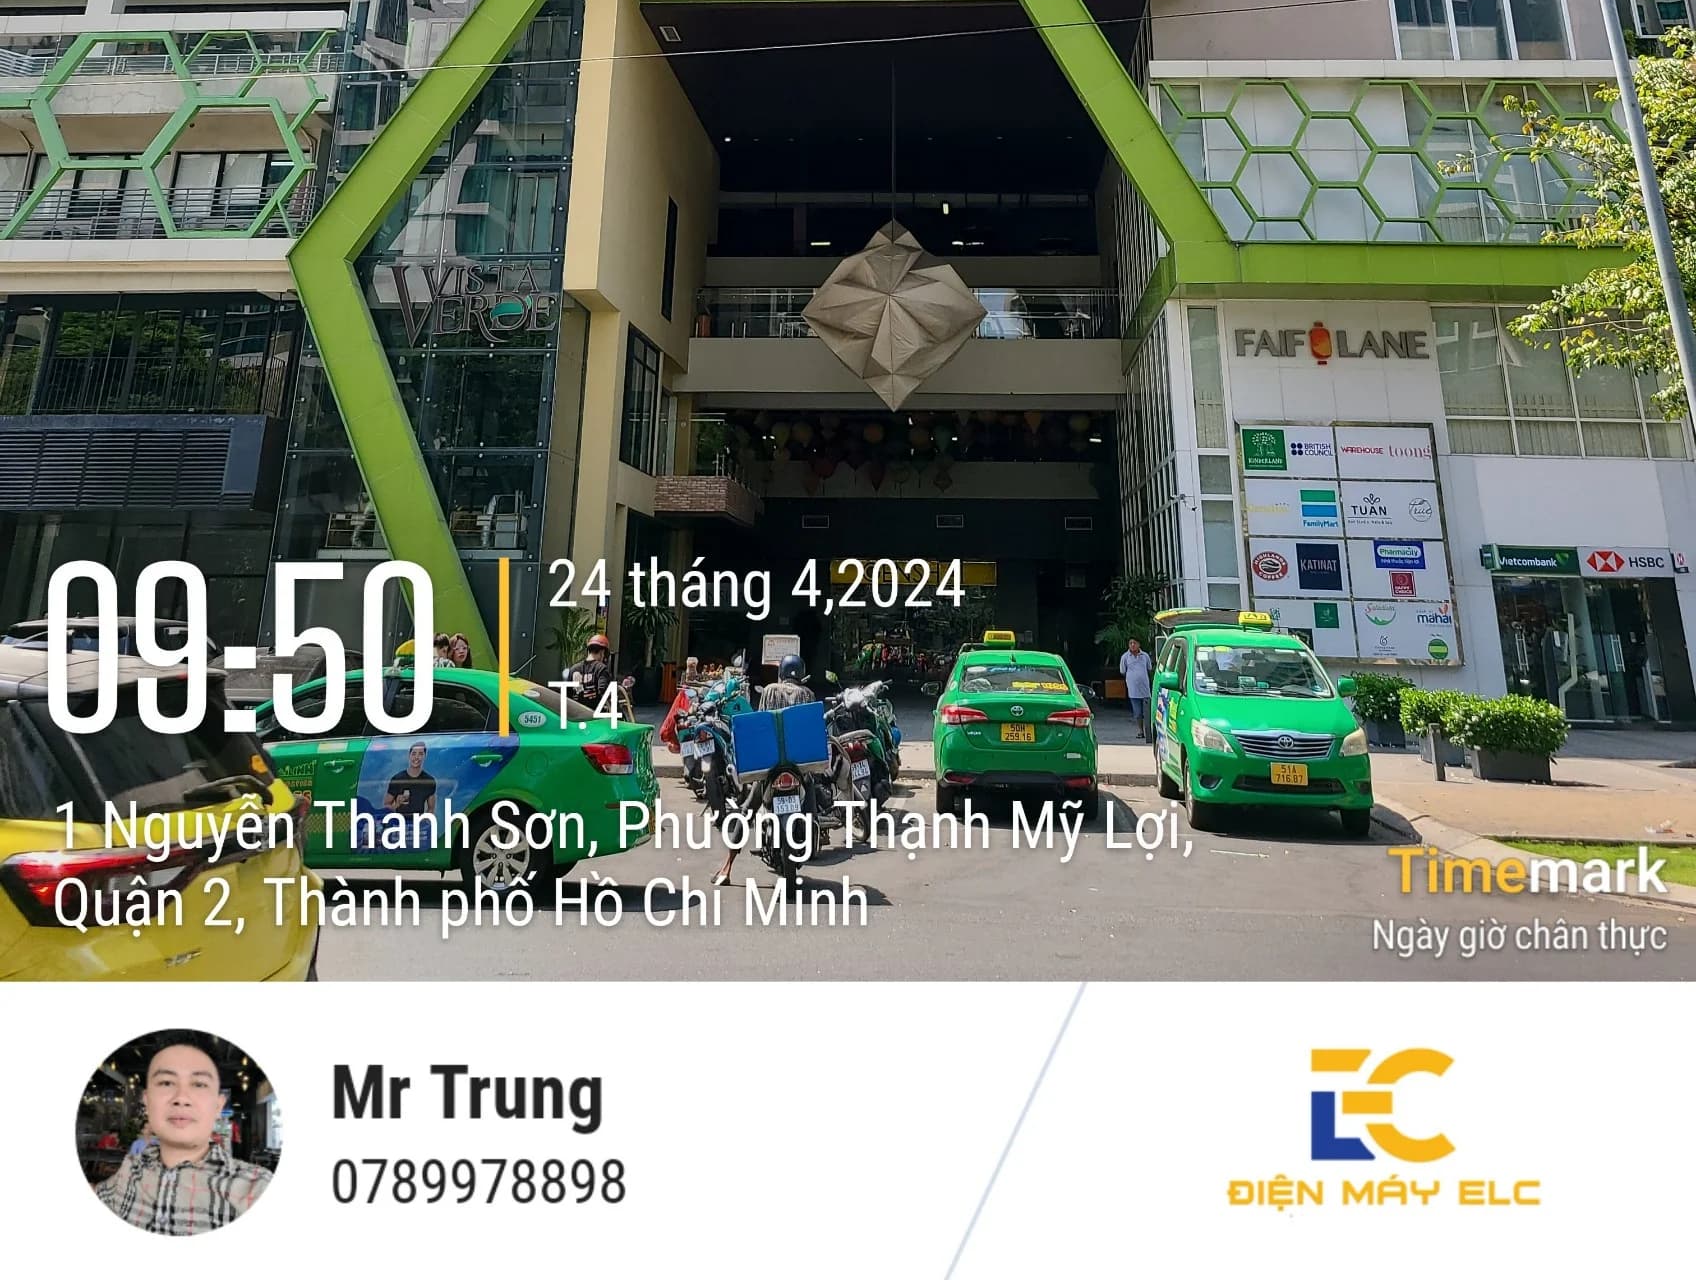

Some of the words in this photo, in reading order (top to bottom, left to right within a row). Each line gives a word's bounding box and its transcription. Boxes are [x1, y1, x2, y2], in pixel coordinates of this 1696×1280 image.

[420, 262, 541, 297] VISTA
[1340, 445, 1384, 455] WAREHOUSE
[1300, 558, 1337, 572] KATINAT
[1499, 556, 1557, 568] Vietcombank
[1628, 556, 1665, 569] HSBC
